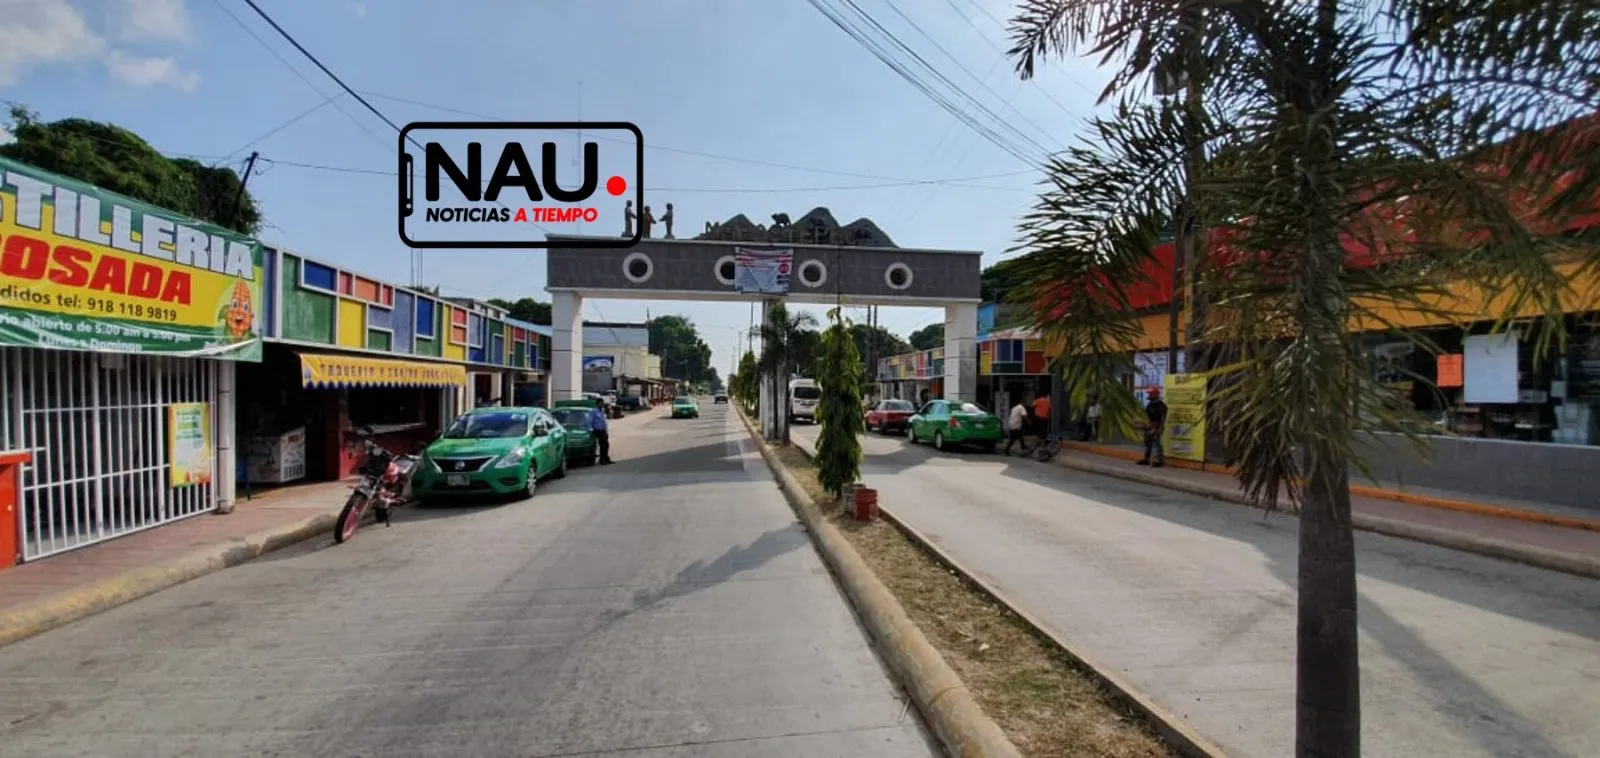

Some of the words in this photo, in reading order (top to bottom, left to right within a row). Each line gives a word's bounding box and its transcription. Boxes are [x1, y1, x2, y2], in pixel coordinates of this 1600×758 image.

[0, 171, 254, 281] TILLERIA
[0, 234, 191, 306] OSADA
[57, 295, 82, 309] tel:
[87, 298, 114, 313] 918
[119, 302, 143, 317] 118
[147, 306, 177, 321] 9819
[76, 319, 93, 334] de
